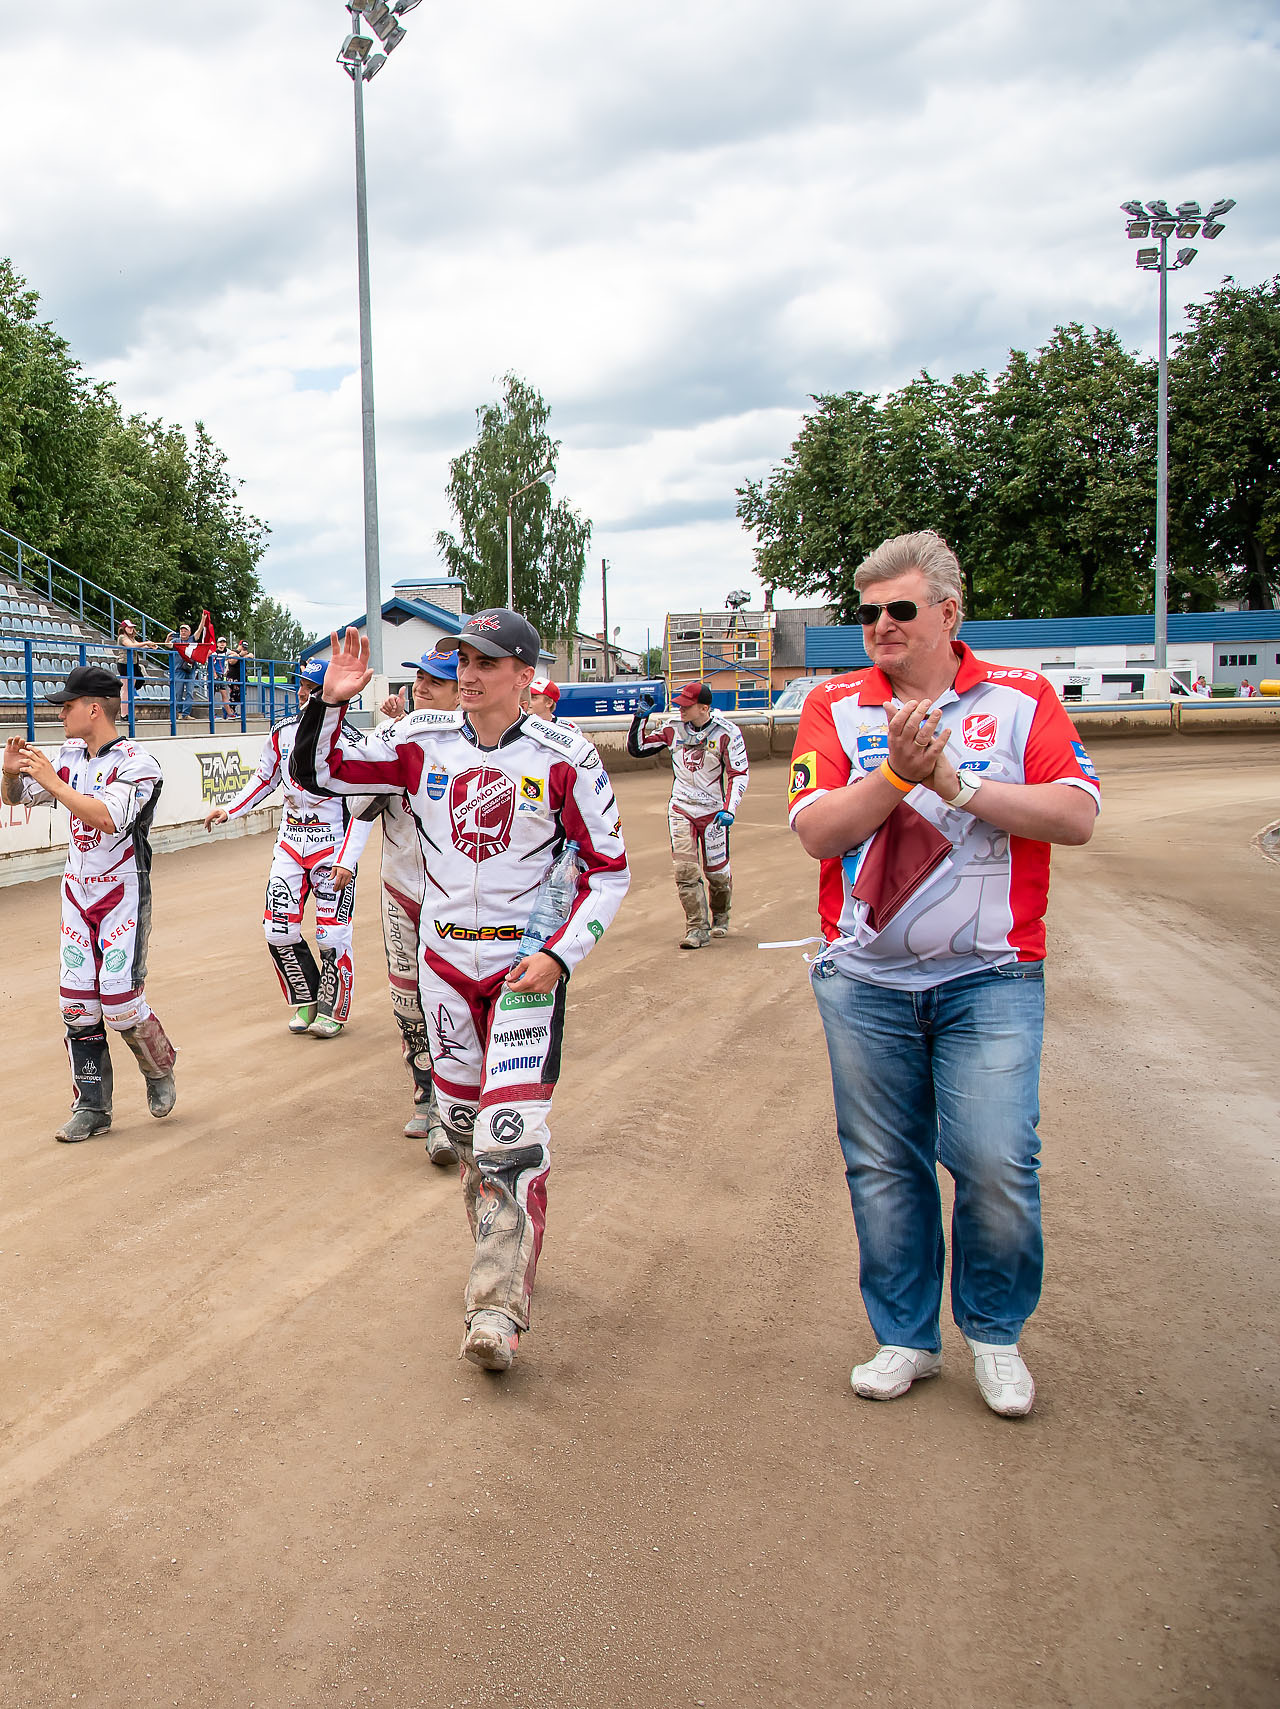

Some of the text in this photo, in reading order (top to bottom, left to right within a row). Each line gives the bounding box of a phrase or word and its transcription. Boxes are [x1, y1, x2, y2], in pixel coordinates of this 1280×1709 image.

[986, 669, 1038, 681] 1963
[454, 778, 508, 820] LOKOMOTIV
[305, 834, 336, 843] North
[271, 889, 289, 935] LIFTS
[65, 926, 90, 948] SELS
[110, 919, 136, 941] SELS
[505, 993, 549, 1006] G-STOCK
[504, 1037, 542, 1048] FAMILY
